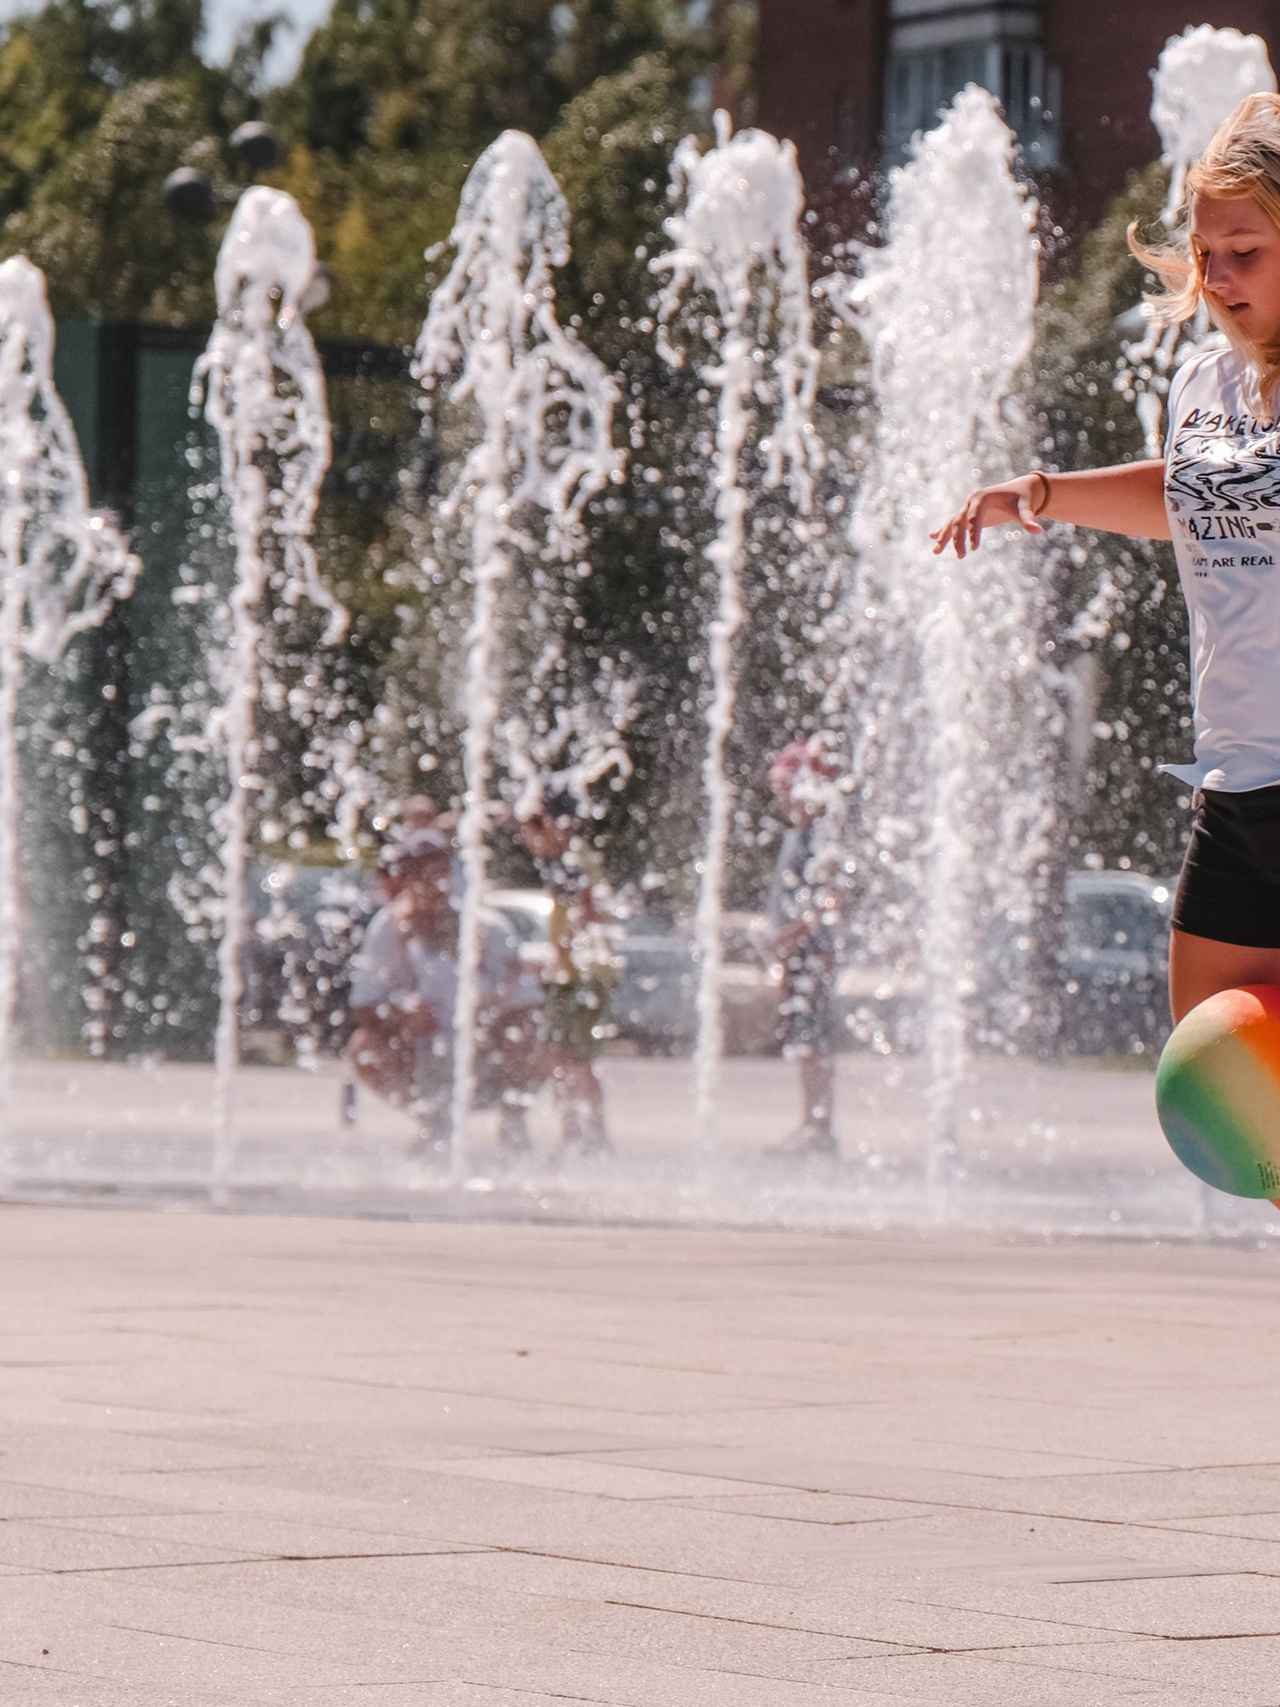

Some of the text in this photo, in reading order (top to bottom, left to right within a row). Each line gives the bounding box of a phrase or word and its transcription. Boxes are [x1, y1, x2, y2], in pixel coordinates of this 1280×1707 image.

[1181, 408, 1249, 436] MAKE
[1212, 557, 1236, 568] ARE
[1241, 555, 1276, 567] REAL
